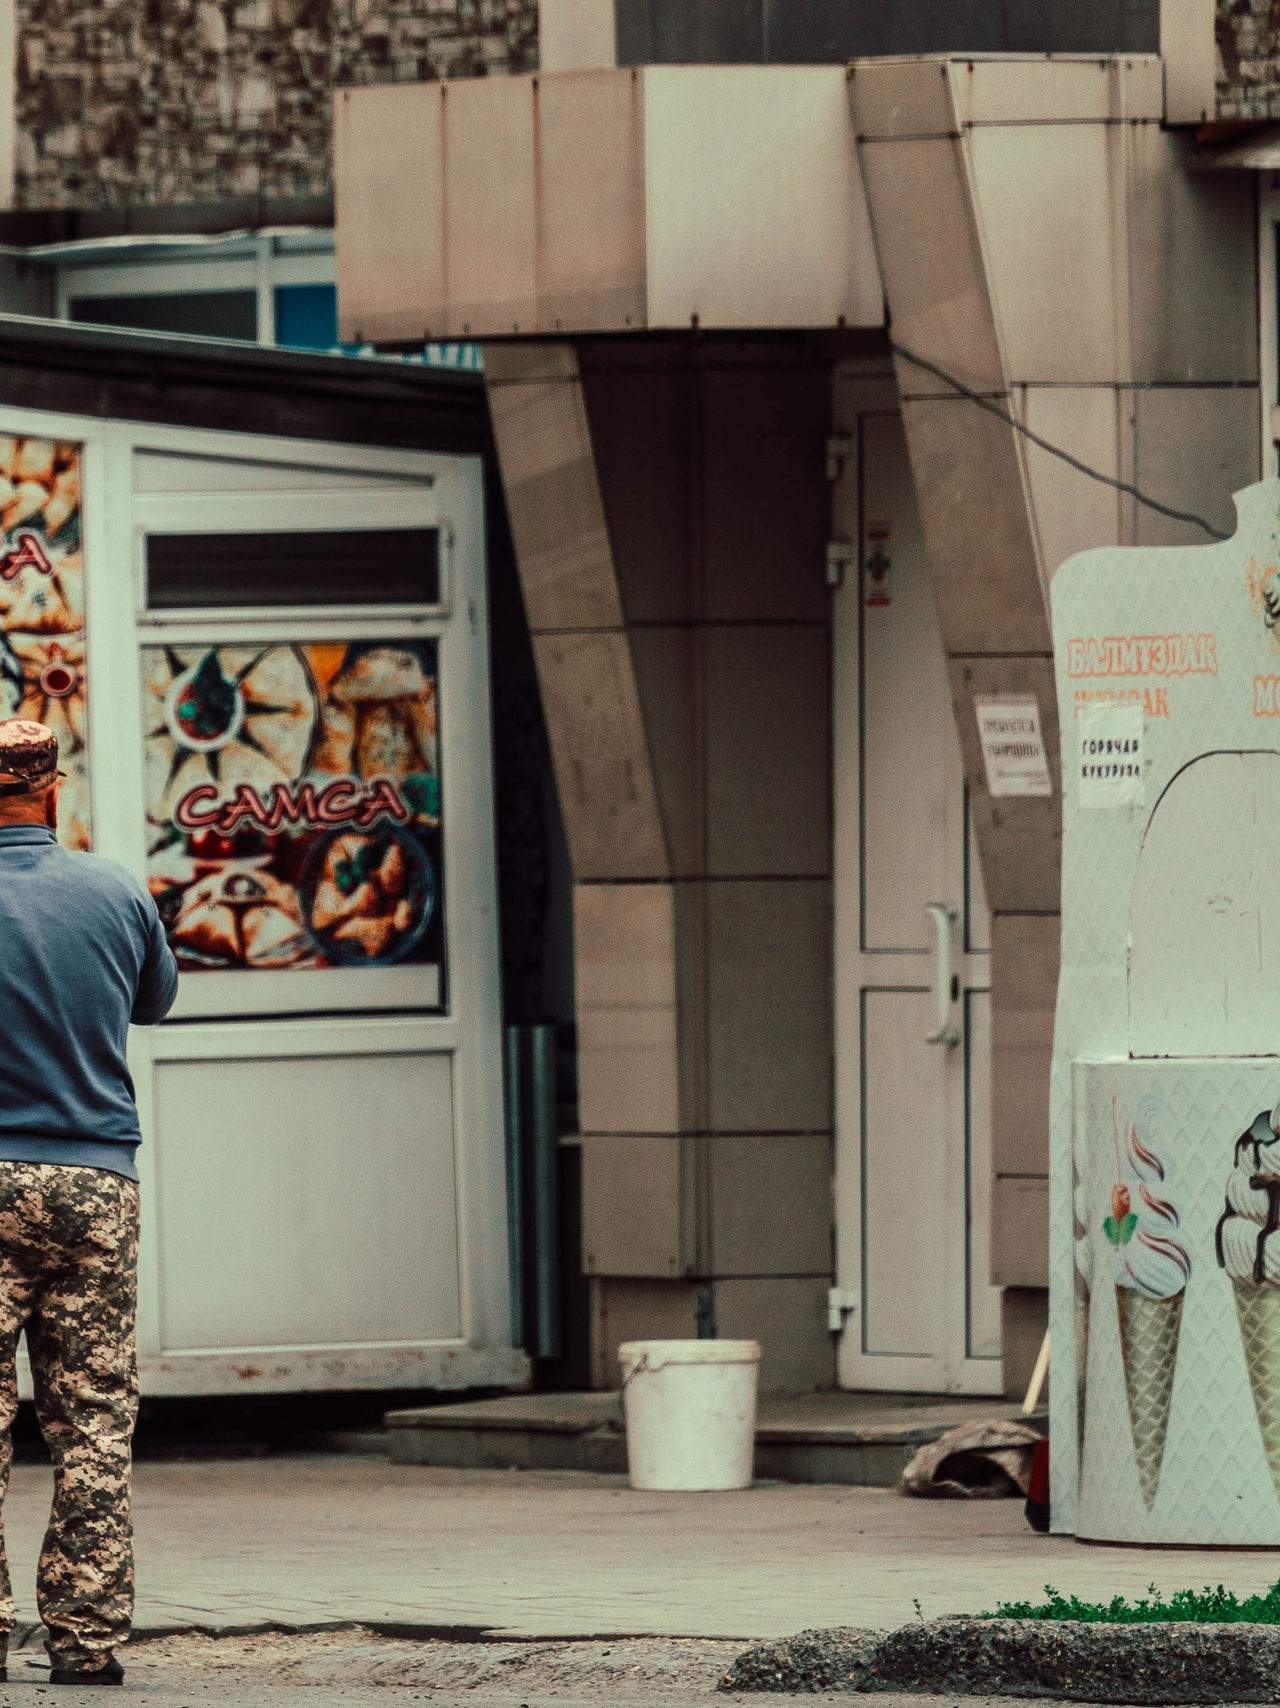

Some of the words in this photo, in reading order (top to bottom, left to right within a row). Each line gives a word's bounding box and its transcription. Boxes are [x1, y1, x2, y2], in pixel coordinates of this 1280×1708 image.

[1081, 738, 1140, 756] ГОРЯЧАЯ
[1081, 764, 1141, 779] КУКУРУЗА
[175, 777, 410, 833] САМСА
